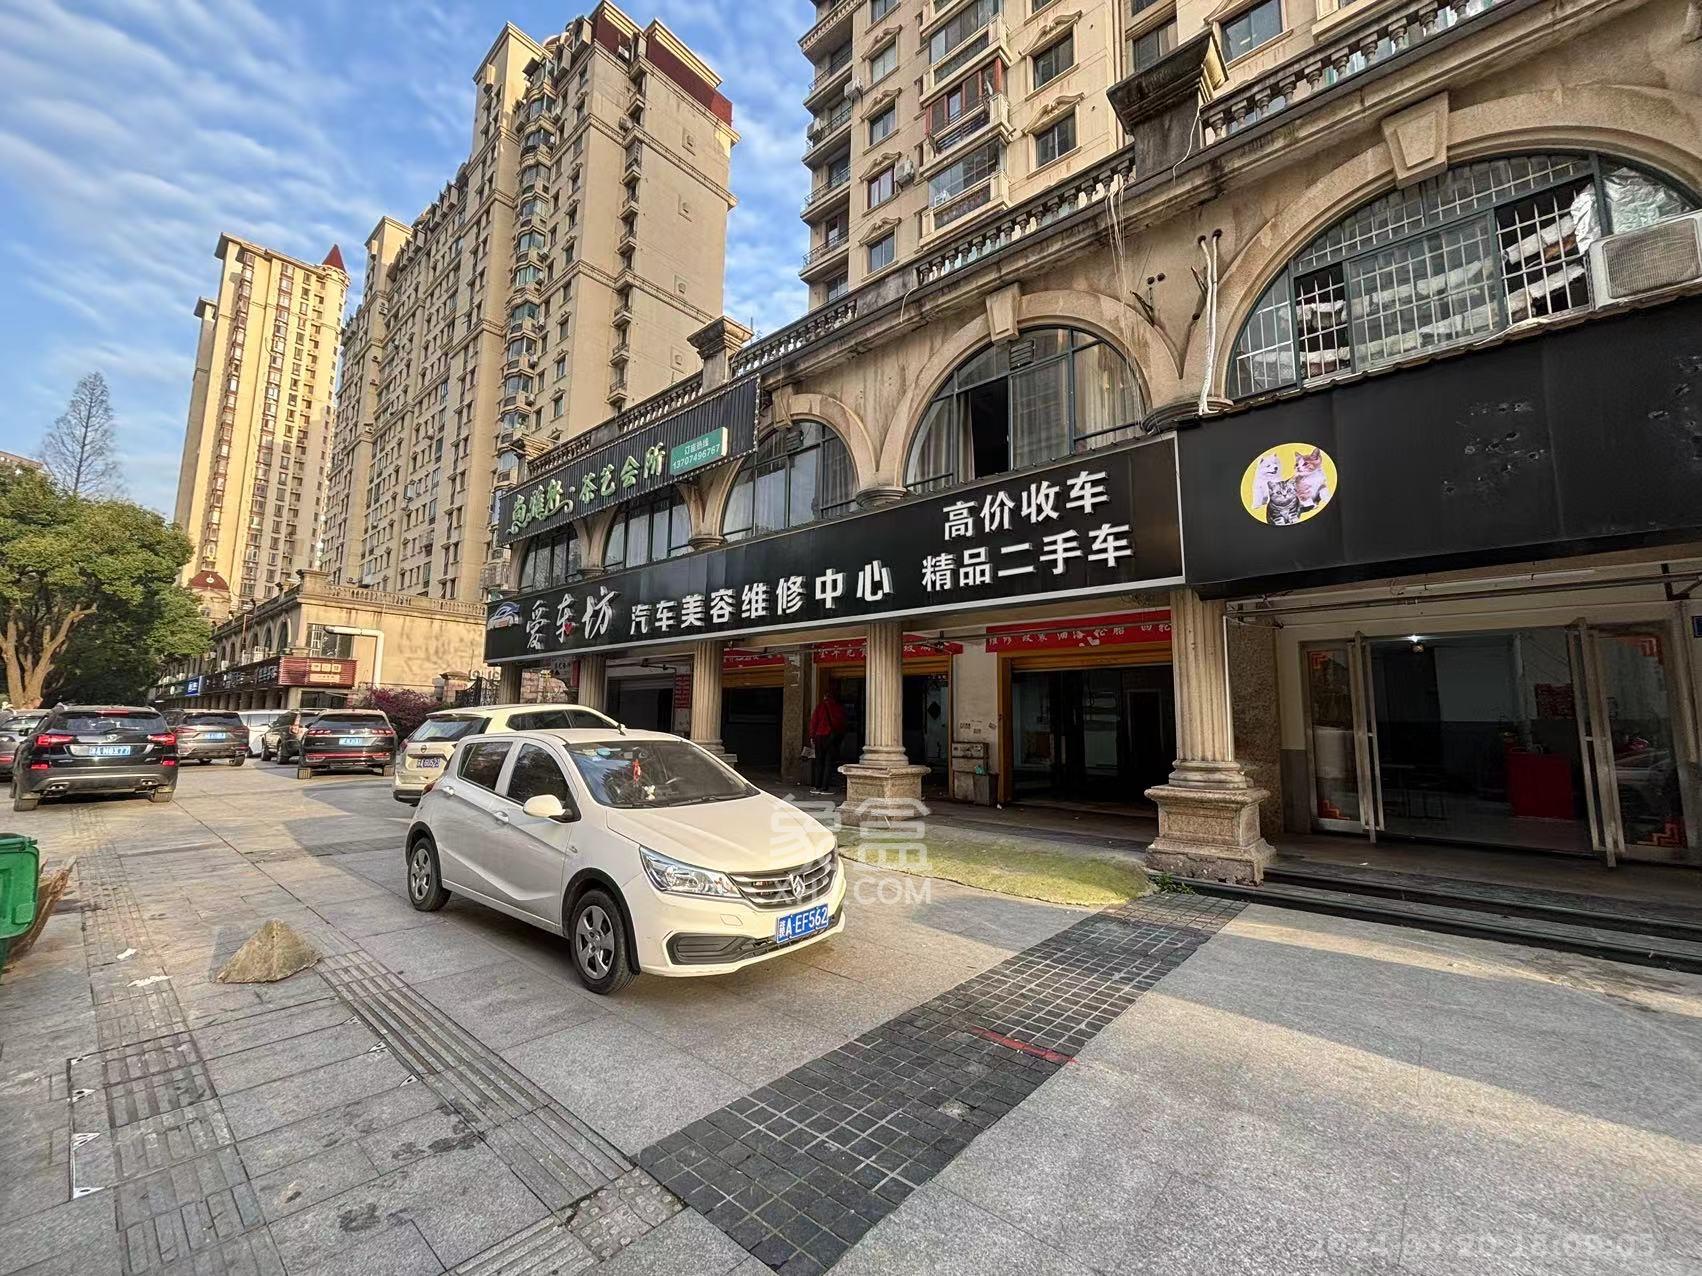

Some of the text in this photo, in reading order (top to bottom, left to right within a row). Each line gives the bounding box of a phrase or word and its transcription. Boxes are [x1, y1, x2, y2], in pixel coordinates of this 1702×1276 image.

[943, 470, 1111, 541] 高价收车
[921, 523, 1135, 592] 精品二手车
[526, 585, 622, 651] 爱车坊
[628, 560, 894, 635] 汽车美容维修中心
